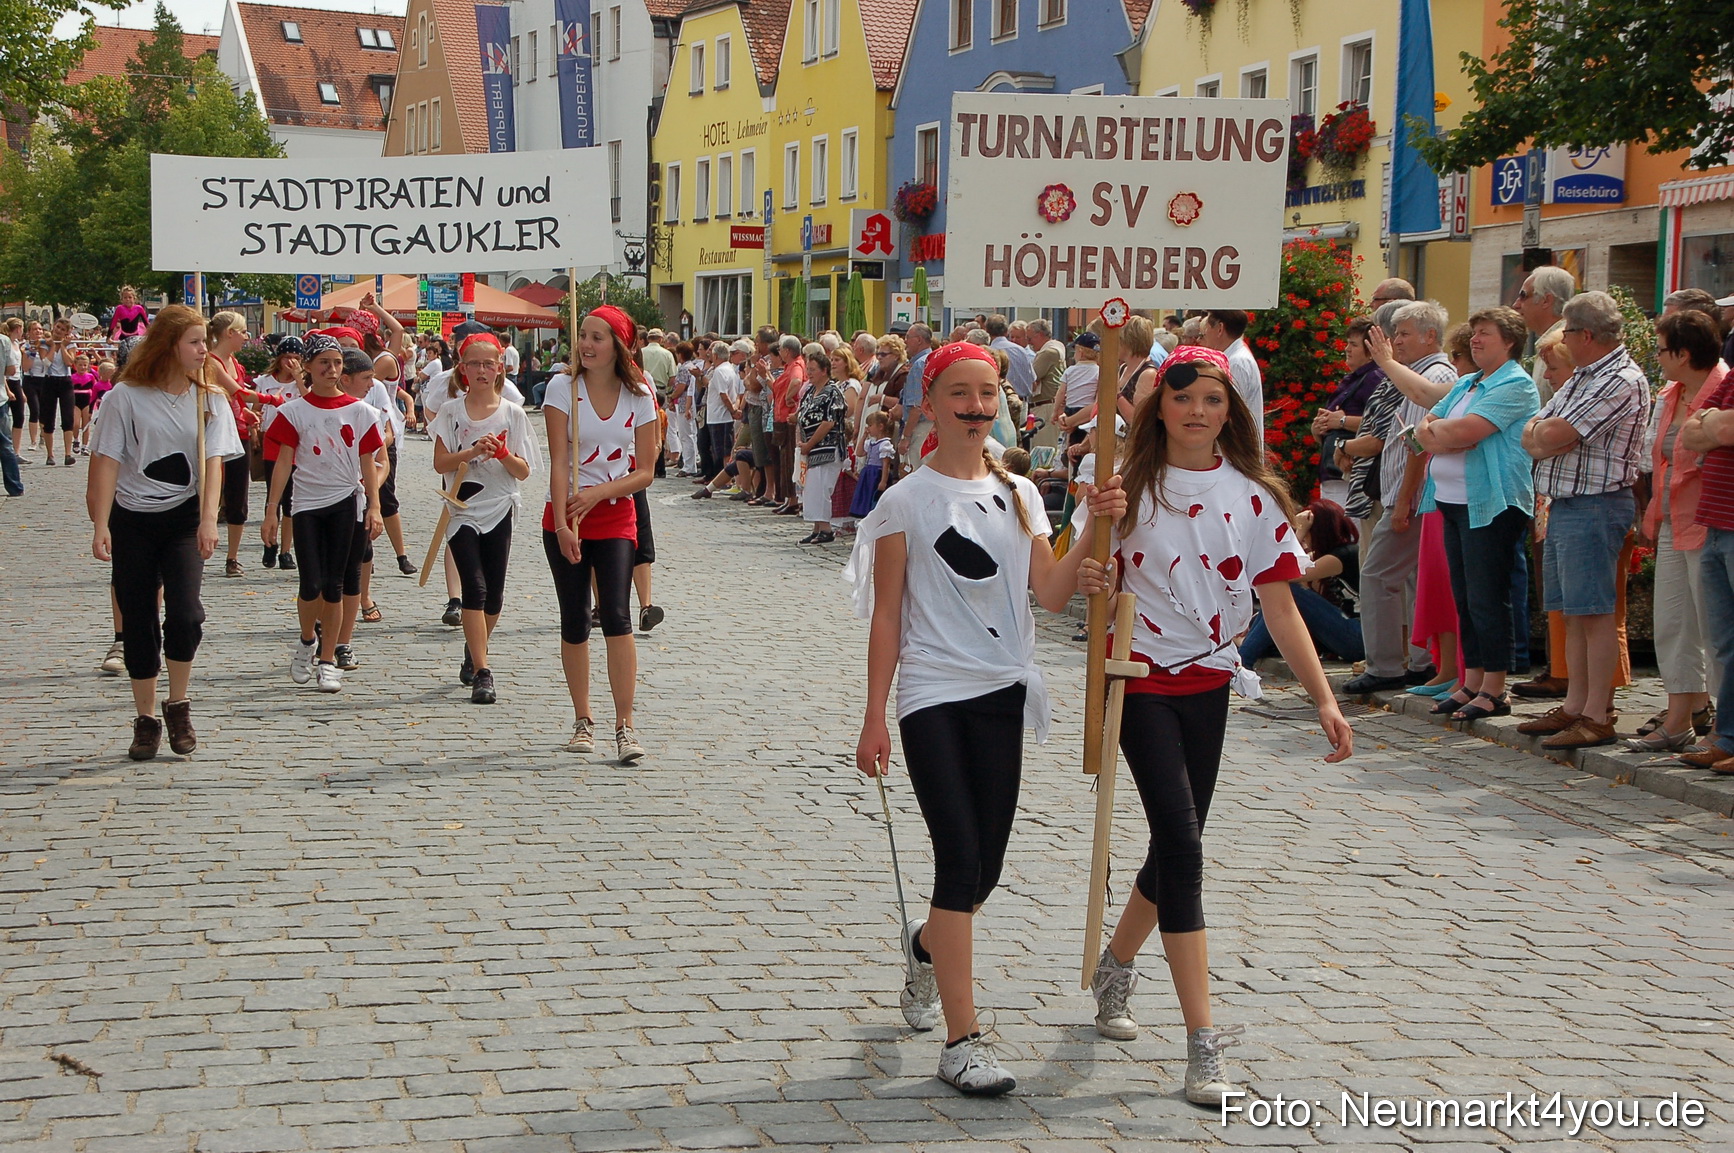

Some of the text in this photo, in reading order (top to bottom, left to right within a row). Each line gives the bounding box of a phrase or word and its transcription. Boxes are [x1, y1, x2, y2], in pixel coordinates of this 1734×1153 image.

[575, 62, 588, 139] RUPPERT
[703, 117, 768, 148] HOTEL Lehmeier
[957, 112, 1286, 163] TURNABTEILUNG
[1528, 157, 1538, 199] P
[1557, 186, 1619, 198] Reisebüro
[202, 175, 551, 212] STADTPIRATEN und
[765, 195, 771, 220] P
[1455, 176, 1467, 233] INO
[239, 216, 561, 257] STADTGAUKLER
[732, 232, 764, 242] WISSMAC
[804, 220, 810, 246] P
[908, 233, 946, 262] APOTH
[699, 248, 737, 265] Restaurant
[984, 232, 1241, 290] HÖHENBERG
[187, 296, 204, 304] TAI
[299, 298, 319, 307] TAXI
[523, 316, 553, 326] Lehmeier
